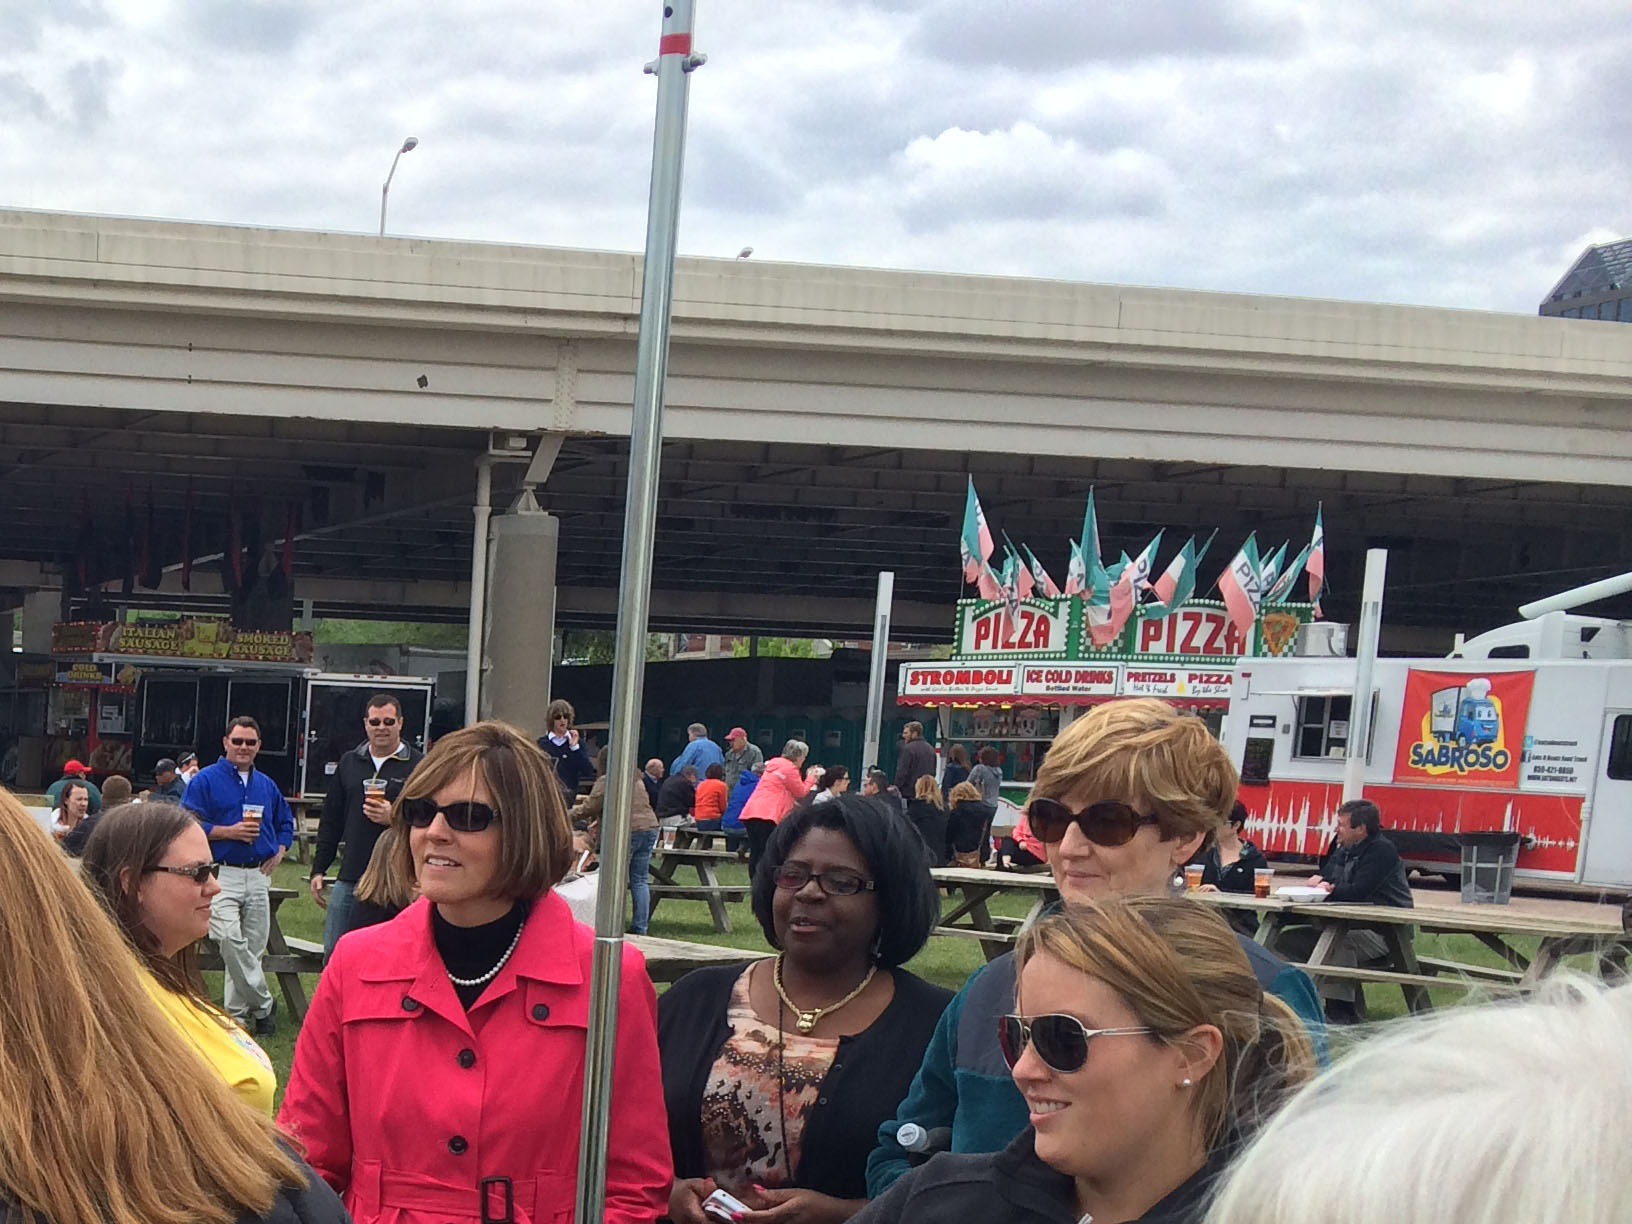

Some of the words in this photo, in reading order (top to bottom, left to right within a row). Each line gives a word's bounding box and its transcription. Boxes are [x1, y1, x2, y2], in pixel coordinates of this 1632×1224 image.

[122, 627, 177, 639] ITALIAN
[974, 611, 1051, 650] PIZA
[1139, 611, 1247, 655] PIZZA
[118, 638, 178, 650] SAUSAGE
[236, 633, 290, 646] SMOKED
[233, 644, 291, 656] SAUSAGE
[909, 669, 1013, 685] STROMBOLI
[1026, 669, 1043, 683] ICE
[1045, 670, 1072, 683] COLD
[1074, 670, 1114, 684] DRINKS
[1127, 672, 1176, 683] PRETZELS
[1188, 673, 1233, 685] PIZZA
[1410, 743, 1510, 773] SABROSO
